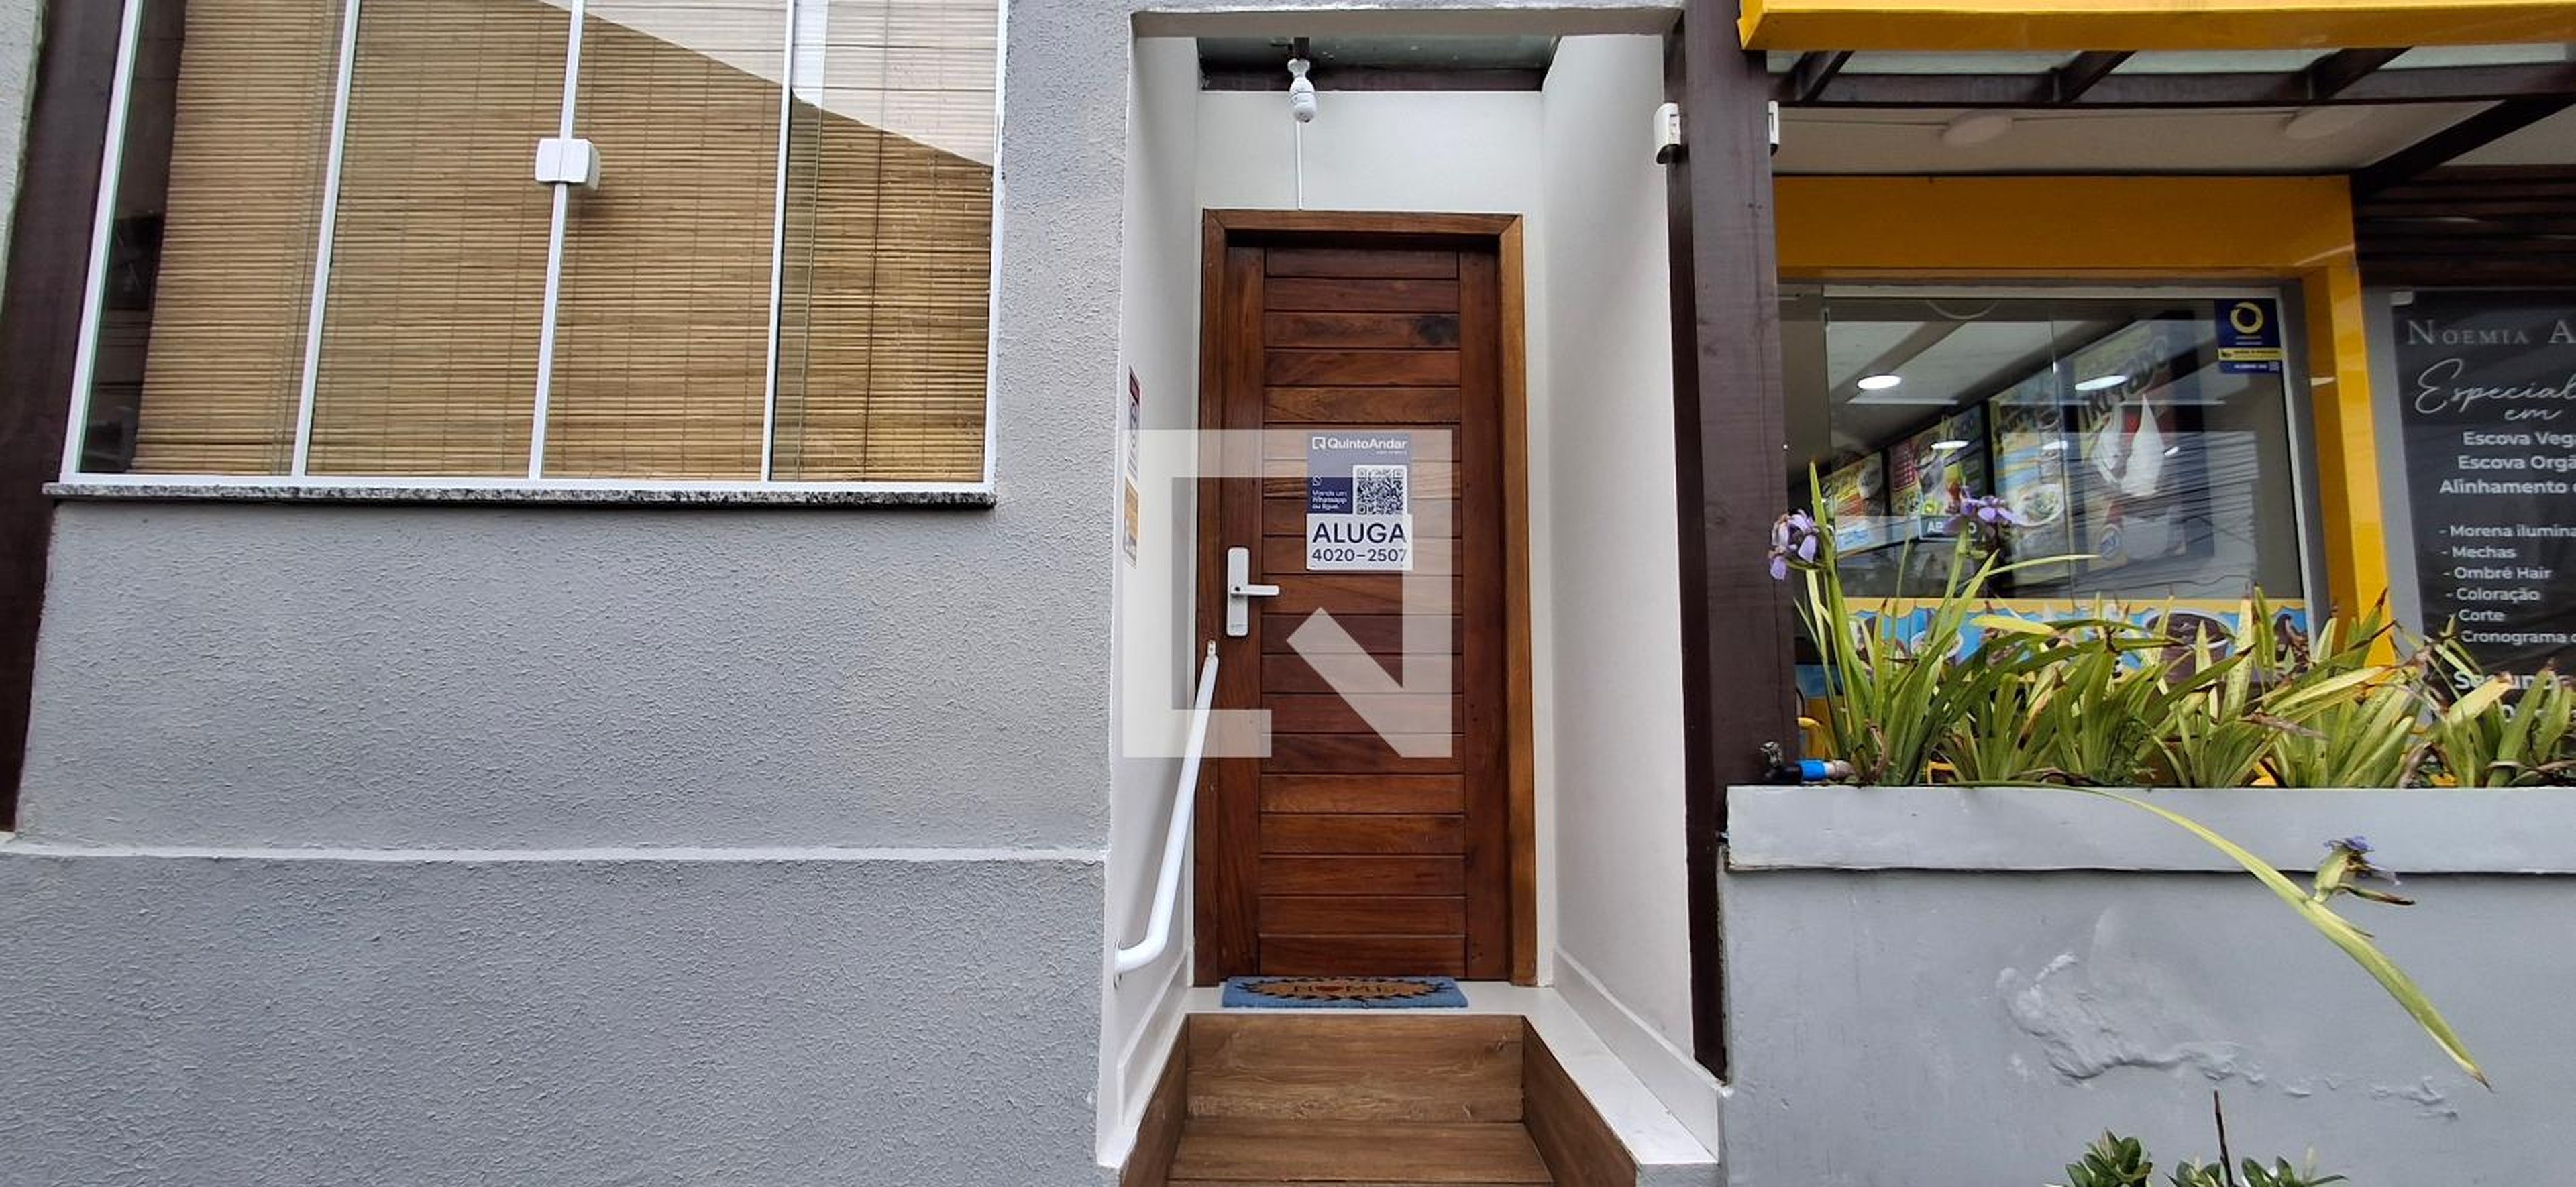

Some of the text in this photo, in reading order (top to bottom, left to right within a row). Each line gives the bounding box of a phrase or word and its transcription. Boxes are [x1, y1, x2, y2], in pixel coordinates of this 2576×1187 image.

[2504, 409, 2563, 421] em
[1327, 437, 1409, 449] QuintoAndar
[2463, 431, 2530, 445] Escova
[2458, 455, 2525, 469] Escova
[2439, 478, 2567, 494] Alinhamento
[1312, 522, 1408, 543] ALUGA
[2450, 525, 2512, 537] Morena
[1311, 549, 1407, 562] 4020-2507
[2451, 546, 2518, 559] Mechas
[2516, 566, 2553, 579] Hair
[2456, 587, 2541, 604] Coloração
[2458, 608, 2506, 622] Corte
[2461, 630, 2567, 646] Cronograma
